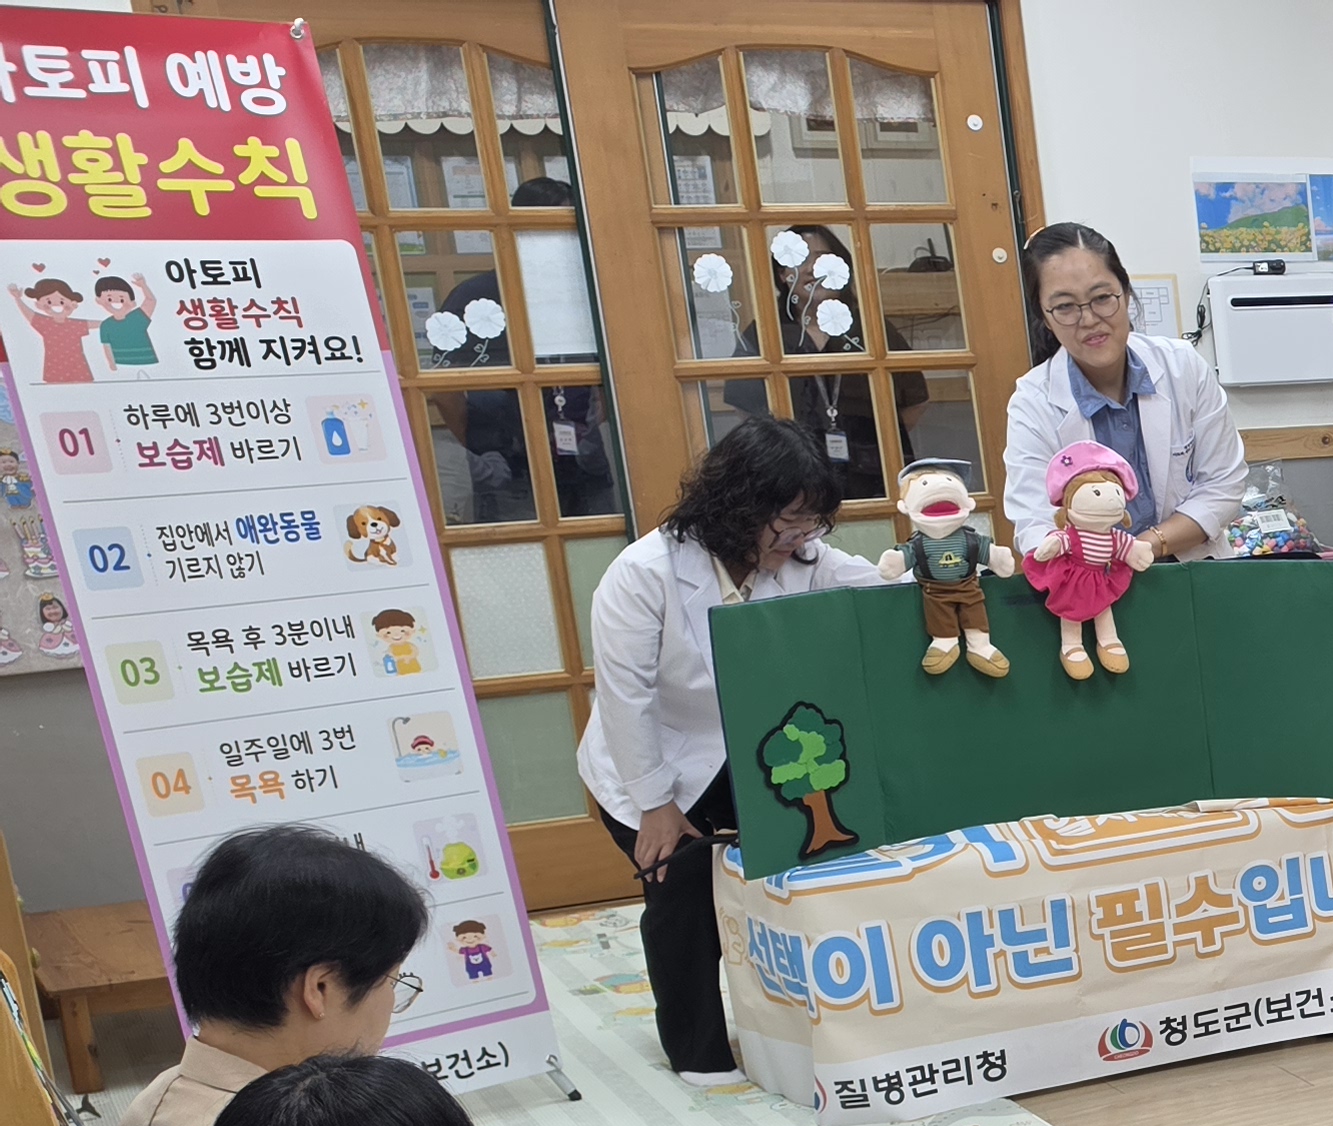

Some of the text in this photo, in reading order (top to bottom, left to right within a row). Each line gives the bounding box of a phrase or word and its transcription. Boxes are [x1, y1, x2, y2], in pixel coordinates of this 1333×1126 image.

[166, 50, 286, 115] 예방
[0, 130, 317, 219] 생활수칙
[165, 258, 261, 289] 아토피
[176, 297, 303, 330] 생활수칙
[184, 335, 363, 370] 함께 지켜요!
[124, 399, 291, 430] 하루에 3번이상
[59, 428, 94, 457] 01
[137, 436, 301, 470] 보습제 바르기
[156, 511, 321, 551] 집안에서 애완동물
[89, 544, 130, 572] 02
[166, 551, 264, 582] 기르지 않기
[187, 615, 355, 656] 목욕 후 3분이내
[121, 657, 160, 686] 03
[198, 653, 356, 692] 보습제 바르기
[220, 725, 355, 767] 일주일에 3번
[152, 769, 191, 799] 04
[230, 765, 337, 804] 목욕 하기
[744, 914, 898, 1015] 선택이
[914, 895, 1076, 992] 아닌
[834, 1049, 1008, 1110] 질병관리청
